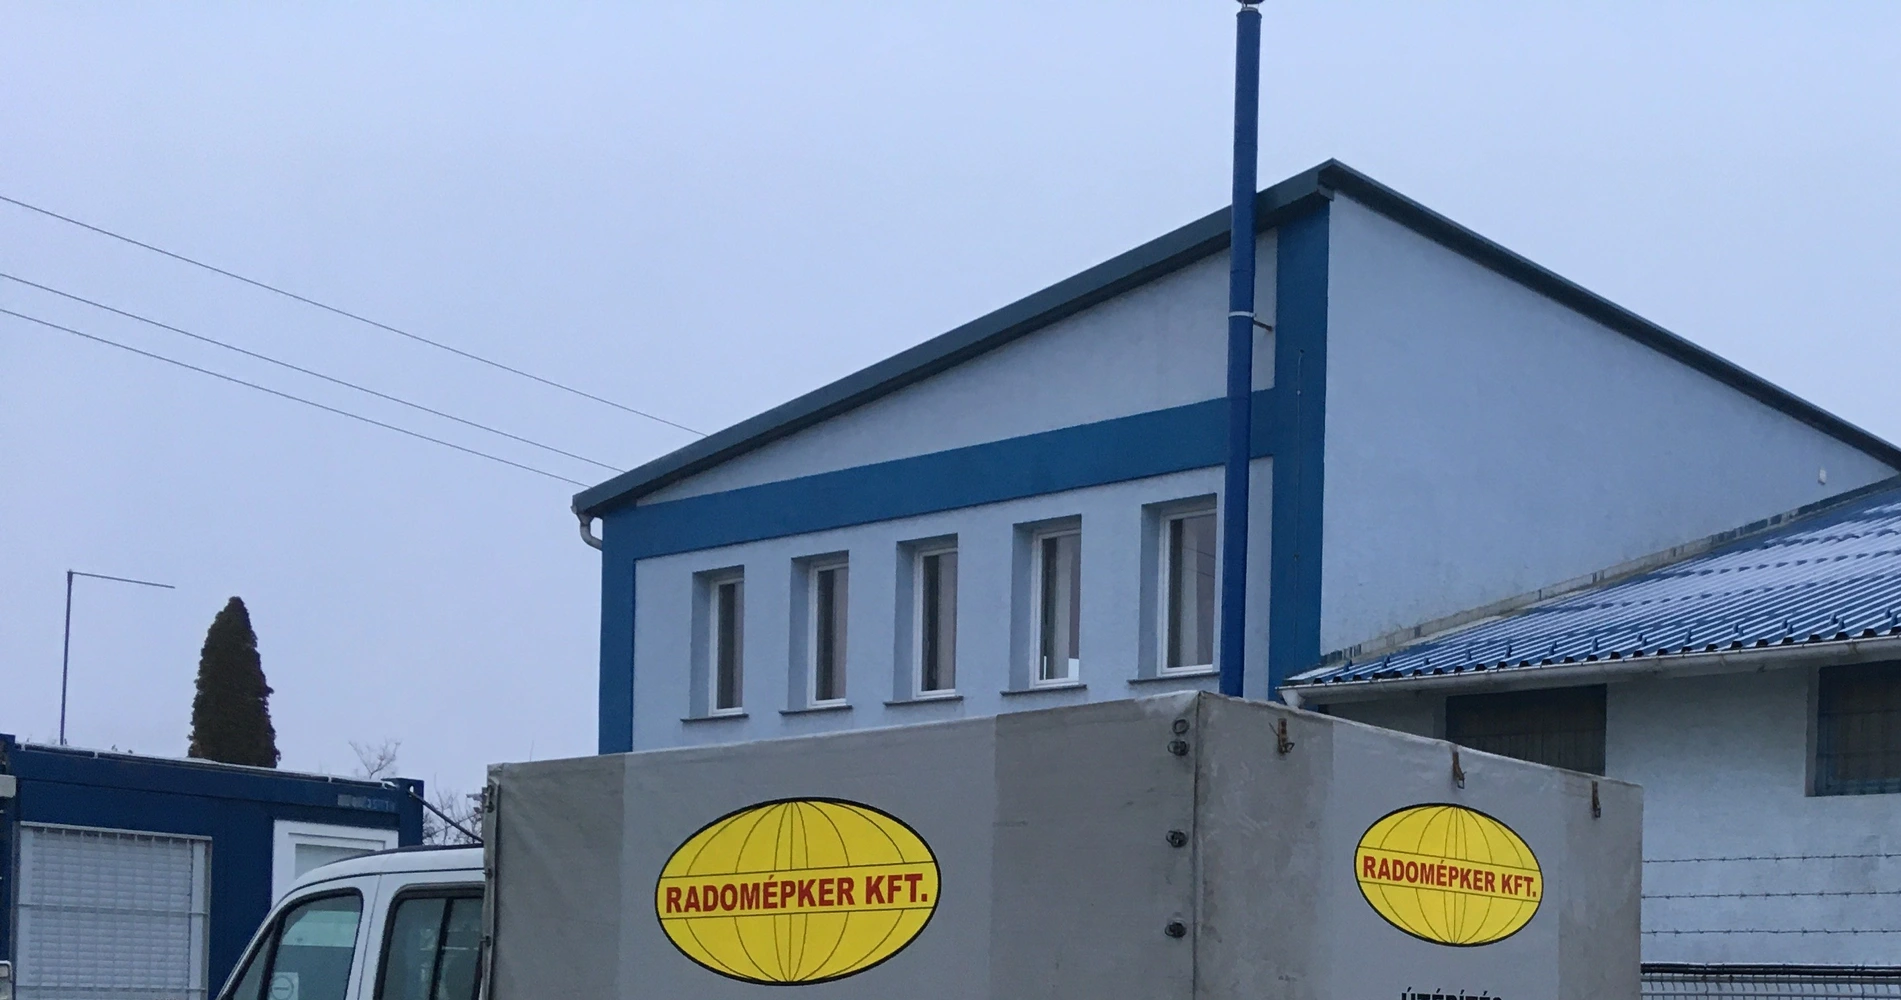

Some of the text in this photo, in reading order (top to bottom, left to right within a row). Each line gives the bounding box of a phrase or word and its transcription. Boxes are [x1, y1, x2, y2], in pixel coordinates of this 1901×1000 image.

[665, 873, 928, 914] RADOMÉPKER KFT.
[1363, 855, 1537, 898] RADOMÉPKER KFT.
